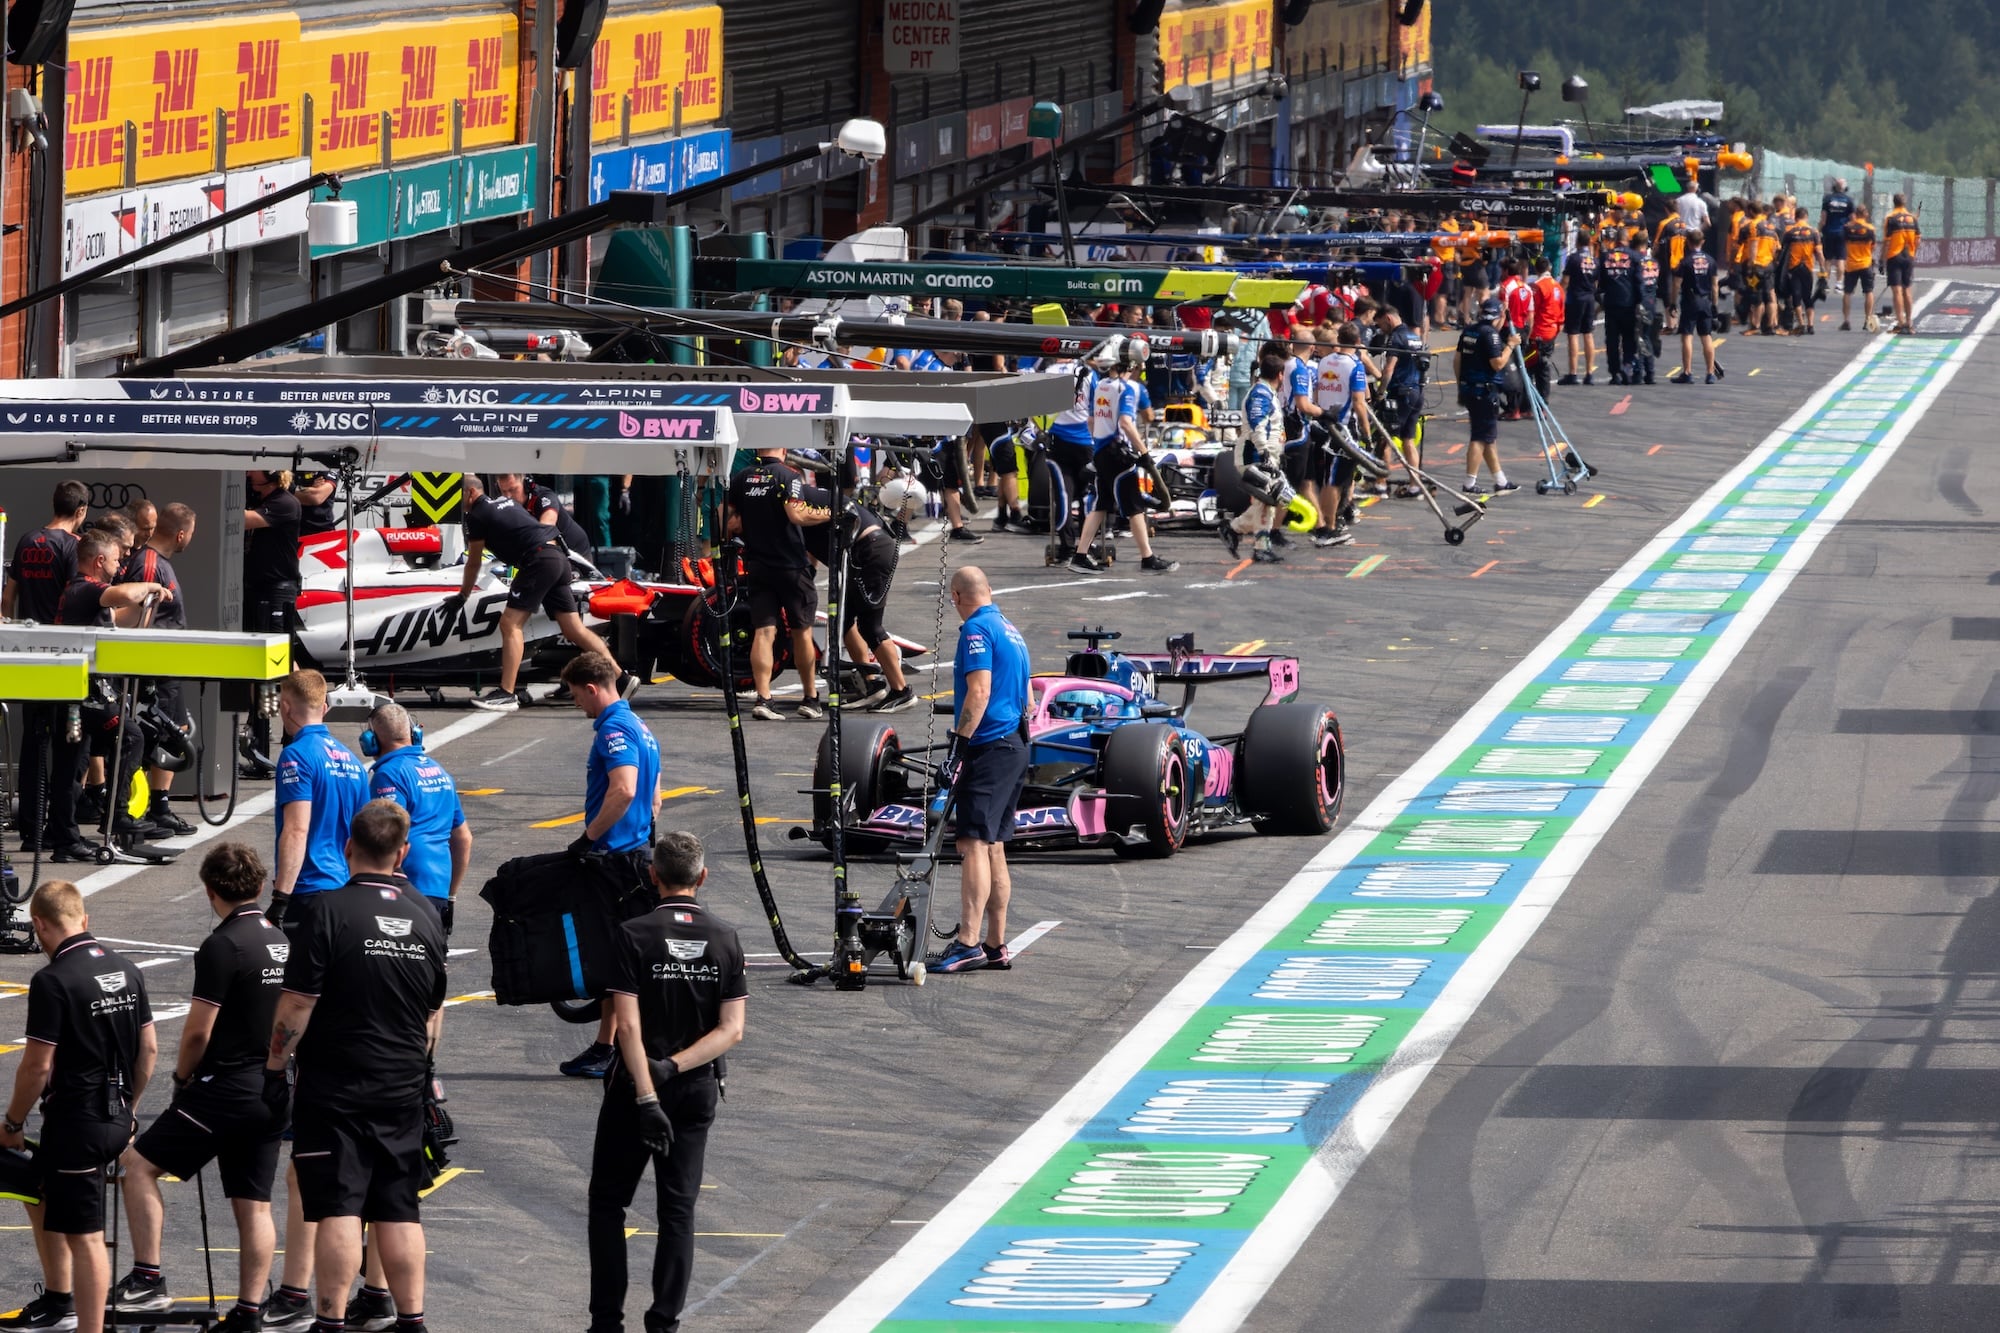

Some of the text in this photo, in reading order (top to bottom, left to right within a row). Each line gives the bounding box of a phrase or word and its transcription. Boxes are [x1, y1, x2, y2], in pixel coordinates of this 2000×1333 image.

[888, 2, 955, 21] MEDICAL
[892, 26, 951, 45] CENTER
[910, 51, 933, 68] PIT
[466, 36, 504, 128] DHL
[235, 39, 280, 144] DHL
[328, 51, 371, 150] DHL
[400, 46, 438, 138] DHL
[152, 48, 200, 156] DHL
[494, 173, 520, 199] ALONSO
[421, 189, 441, 215] STROLL
[1508, 204, 1557, 213] LOGISTICS
[85, 231, 106, 261] OCON
[806, 271, 914, 286] ASTON MARTIN
[925, 273, 994, 289] aramco
[1067, 278, 1143, 293] Built on arm
[1148, 335, 1184, 347] TGR
[175, 388, 821, 413] CASTORE BETTER NEVER STOPS MSC ALPINE BWT
[34, 412, 702, 439] CASTORE BETTER NEVER STOPS MSC ALPINE BWT
[460, 424, 528, 434] FORMULA ONE TEAM
[386, 531, 426, 543] RUCKUS
[340, 592, 511, 656] HAAS
[1183, 739, 1202, 757] SC
[364, 938, 426, 953] CADILLAC
[364, 949, 399, 958] FORMULA
[652, 962, 719, 975] CADILLAC
[652, 973, 690, 981] FORMULA
[90, 993, 137, 1010] CADILLAC
